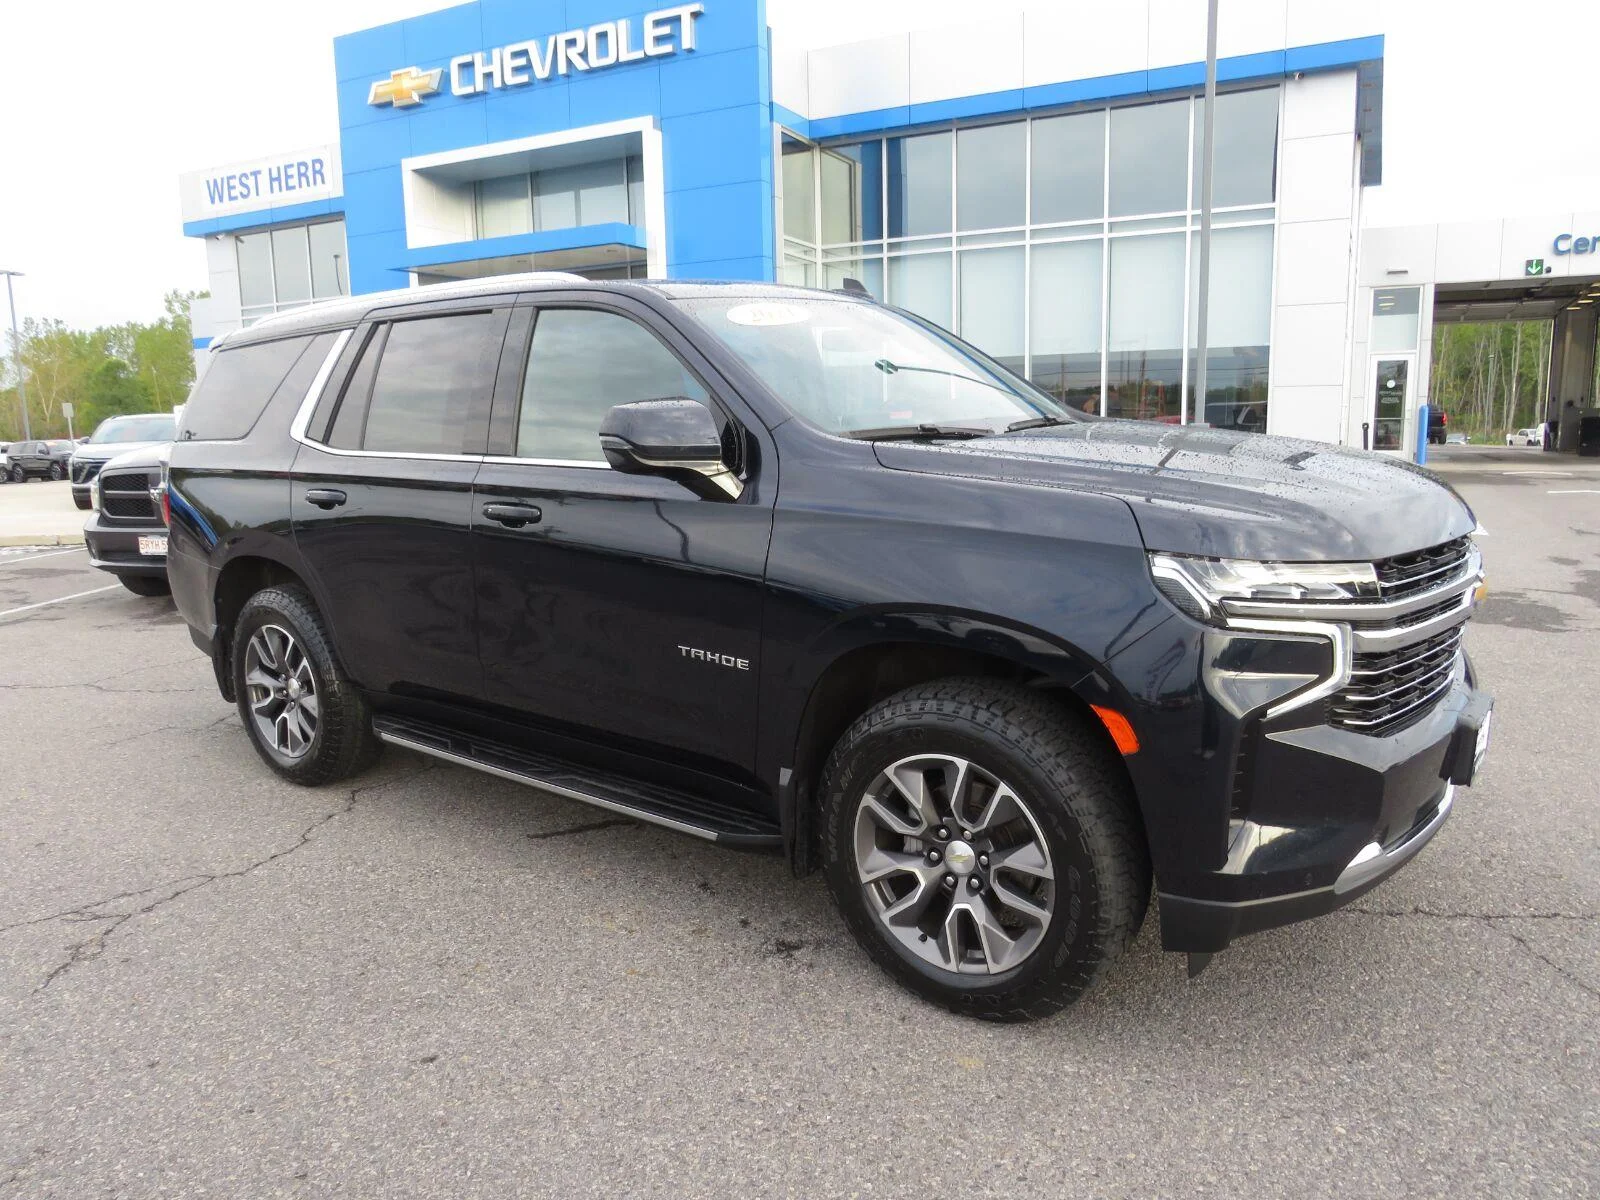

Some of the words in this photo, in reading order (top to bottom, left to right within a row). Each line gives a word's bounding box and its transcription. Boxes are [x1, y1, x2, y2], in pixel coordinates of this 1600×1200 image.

[450, 3, 705, 96] CHEVROLET
[206, 170, 262, 205] WEST
[268, 158, 326, 194] HERR
[1553, 233, 1600, 256] Cer
[678, 645, 750, 670] TAHOE
